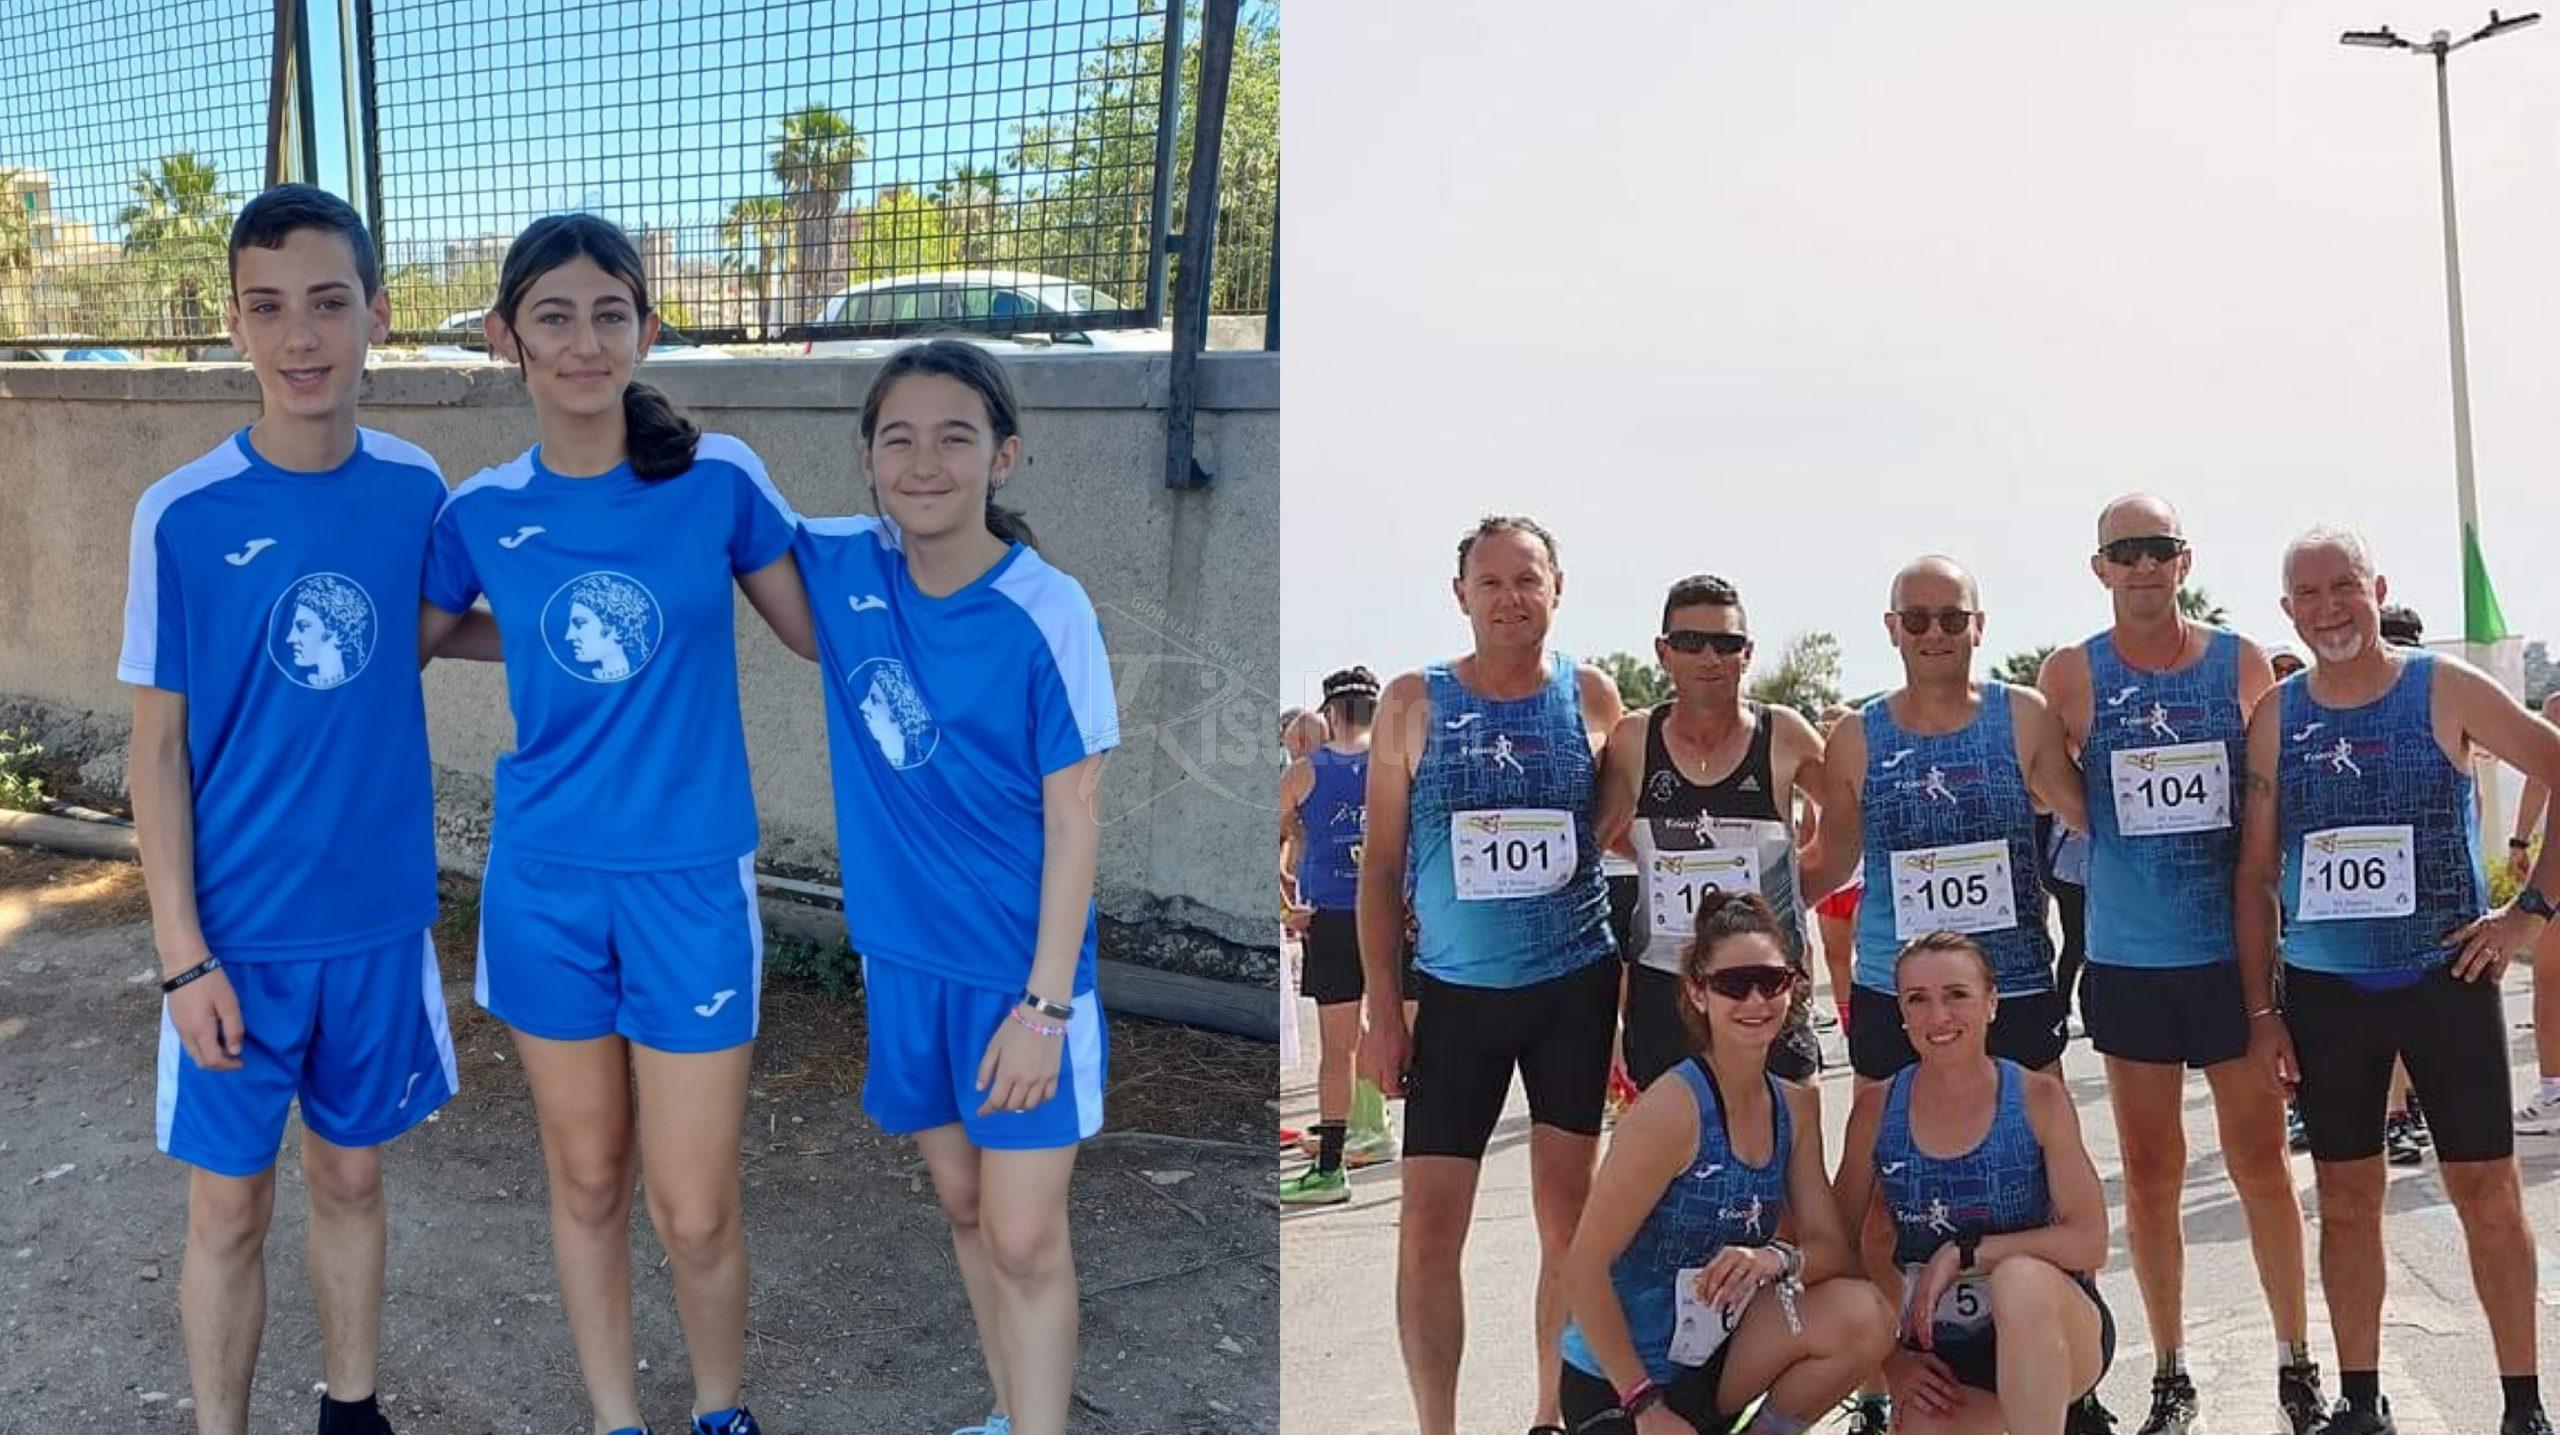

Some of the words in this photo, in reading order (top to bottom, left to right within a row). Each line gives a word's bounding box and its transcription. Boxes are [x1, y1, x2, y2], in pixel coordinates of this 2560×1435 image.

[2137, 773, 2208, 808] 104
[1481, 840, 1548, 872] 101
[2319, 857, 2386, 892] 106
[1917, 874, 1988, 911] 105
